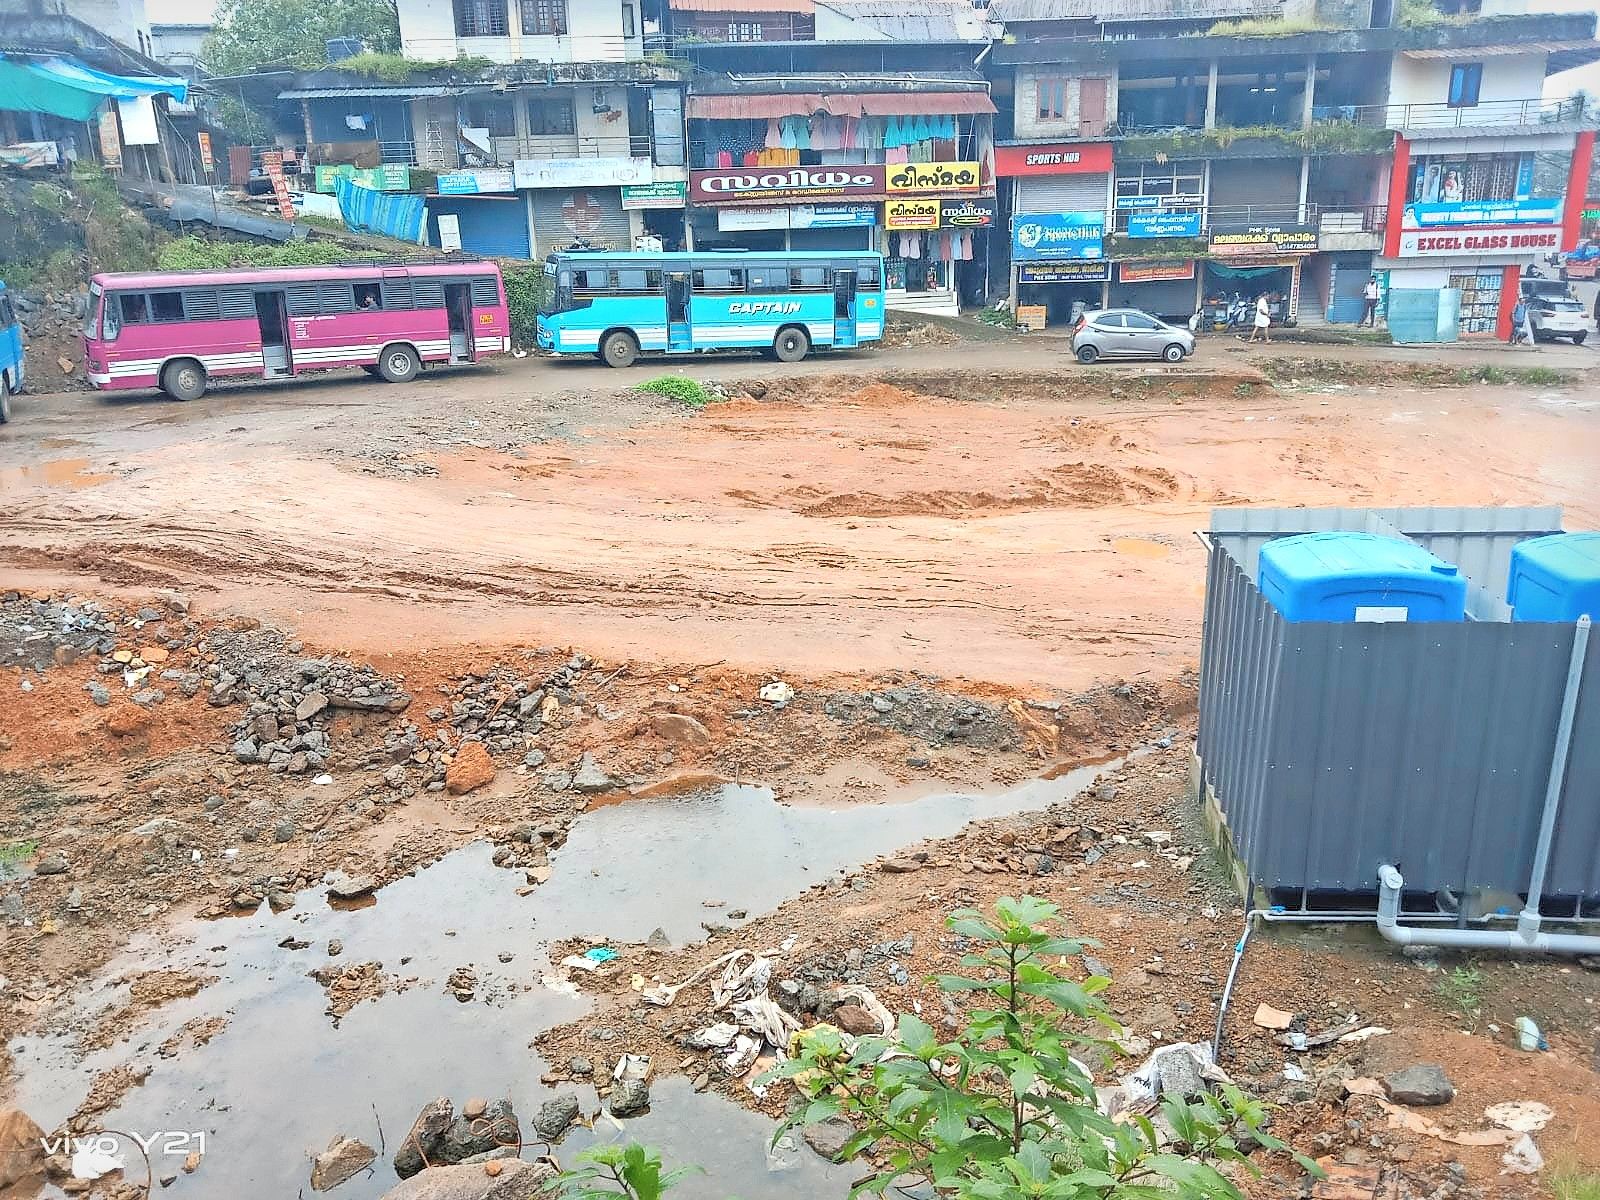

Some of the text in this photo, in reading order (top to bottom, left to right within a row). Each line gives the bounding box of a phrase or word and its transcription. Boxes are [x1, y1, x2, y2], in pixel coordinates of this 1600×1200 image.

[1026, 152, 1080, 165] SPORTS HUB
[700, 170, 875, 193] സവിധം
[891, 165, 975, 187] വിസ്മയ
[890, 203, 937, 216] വിസ്മയ
[1417, 234, 1557, 251] EXCEL GLASS HOUSE
[728, 301, 803, 316] CAPTAIN
